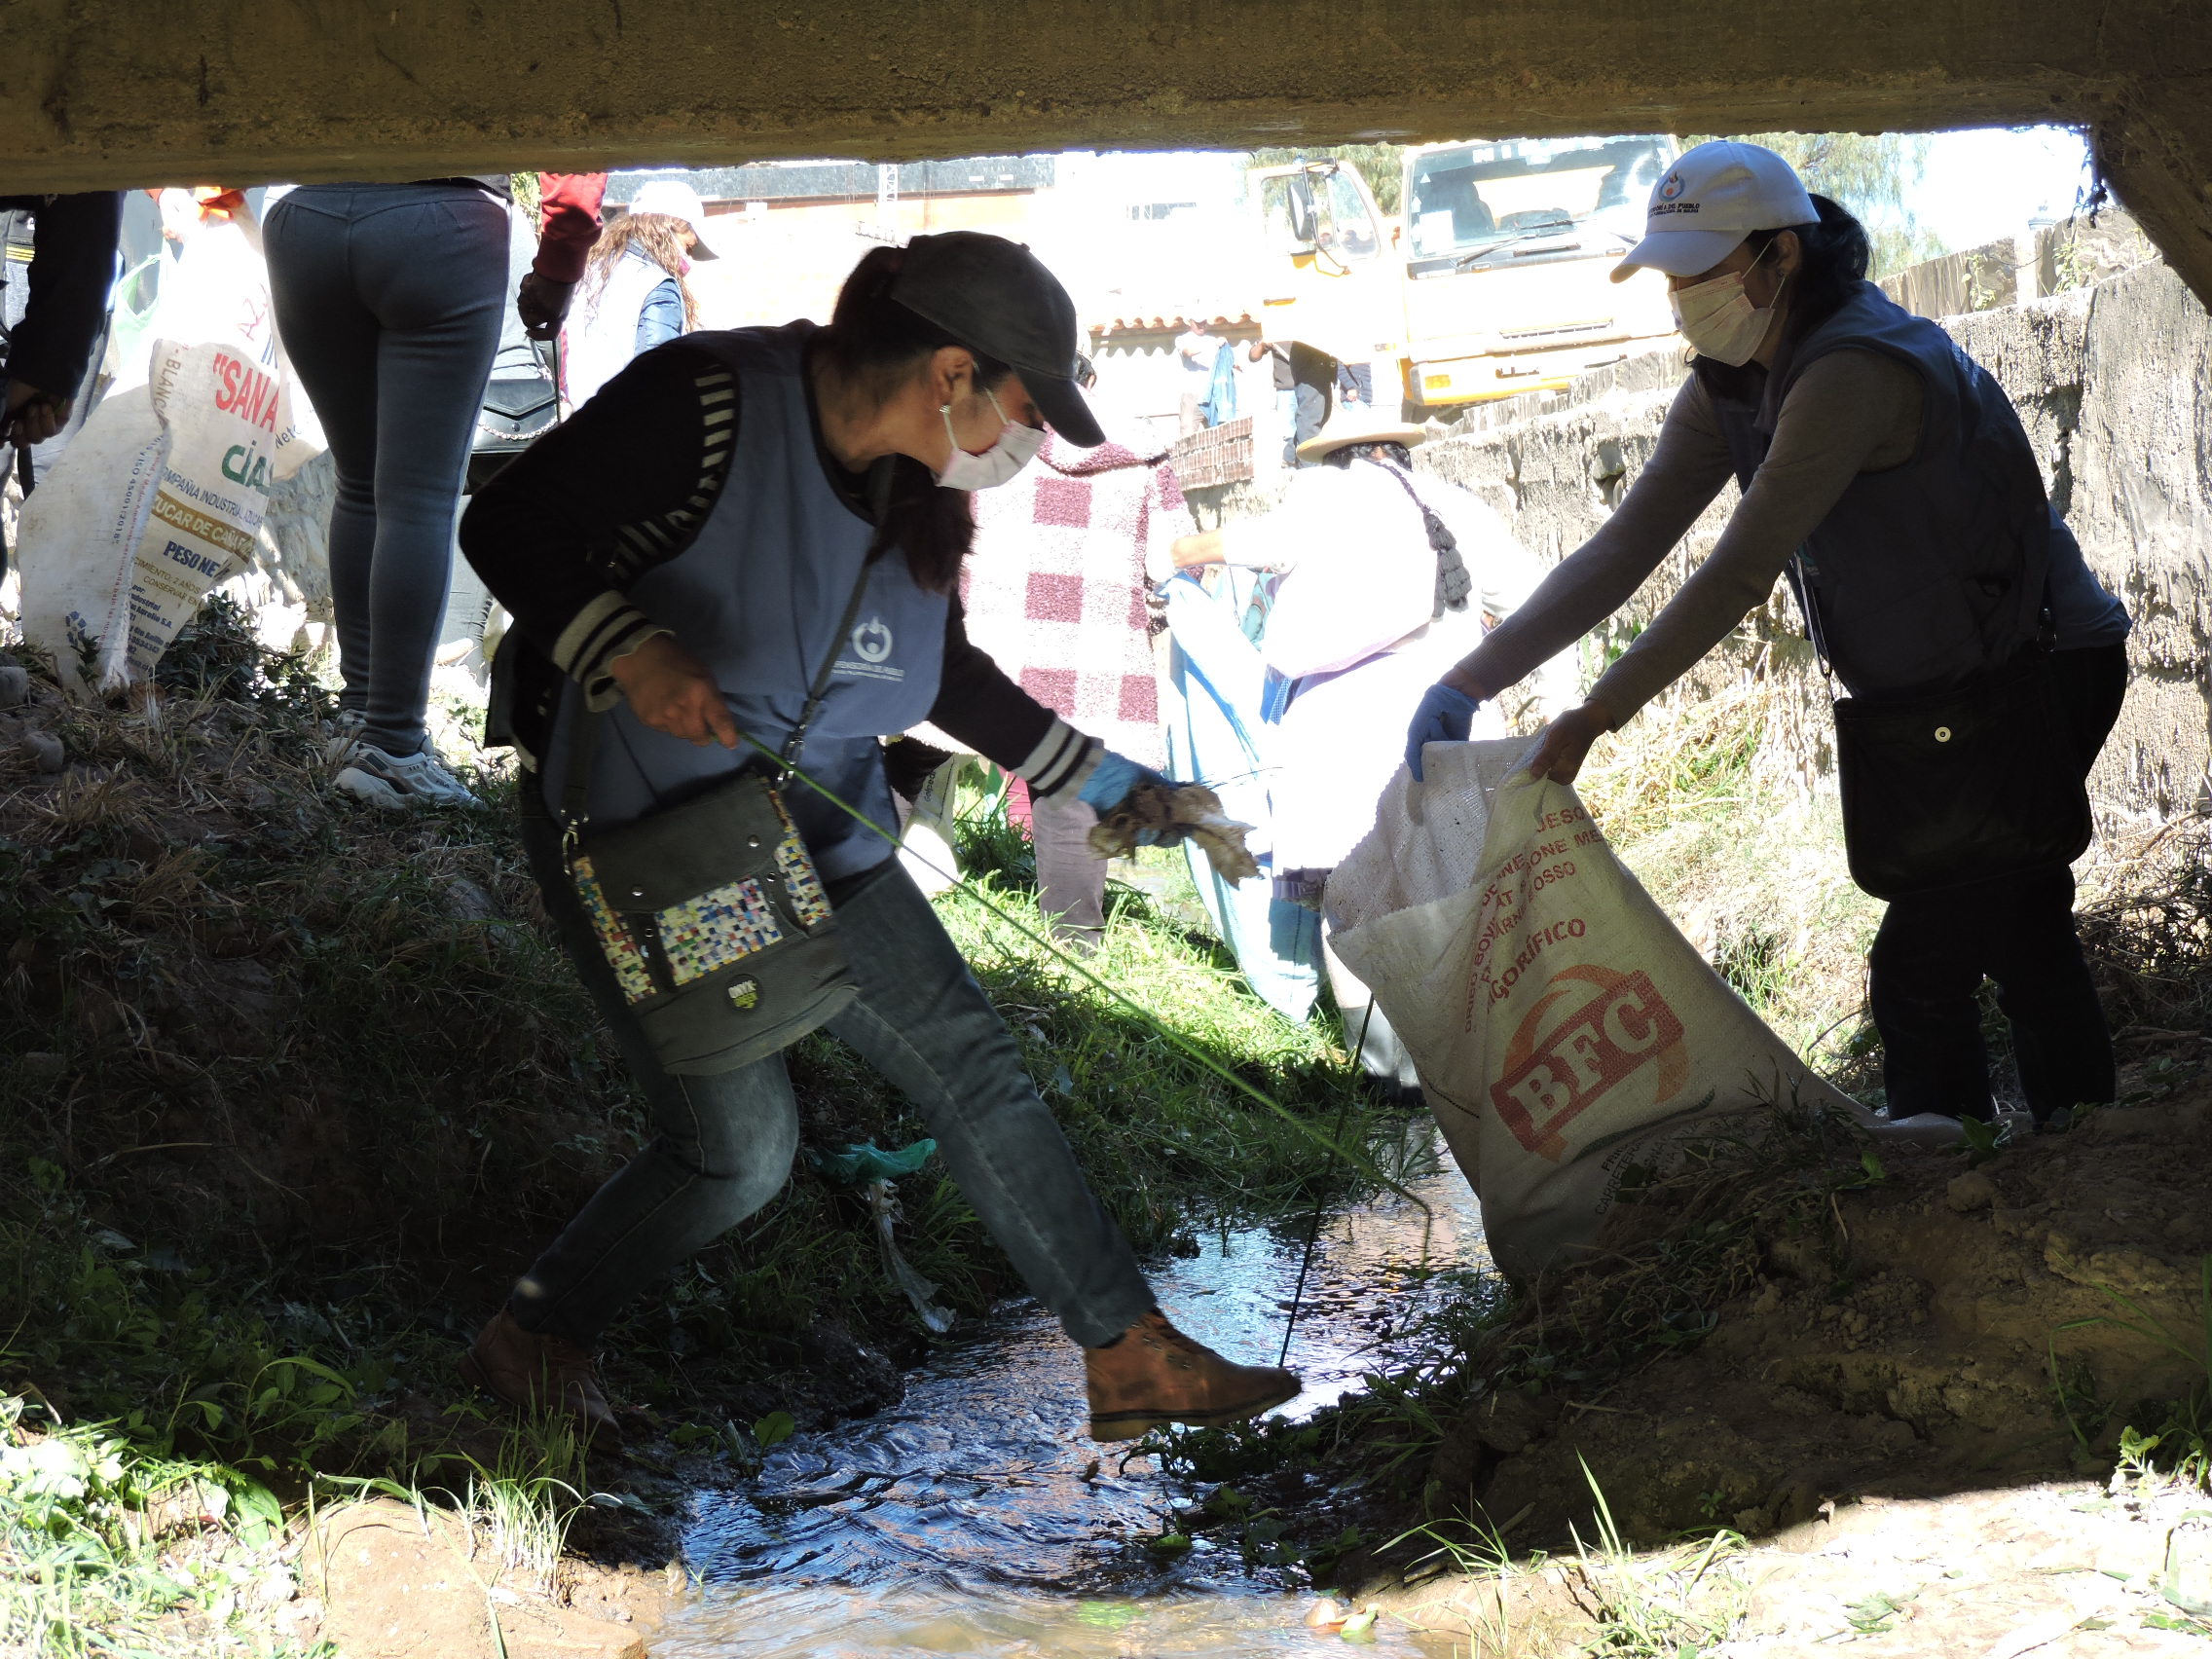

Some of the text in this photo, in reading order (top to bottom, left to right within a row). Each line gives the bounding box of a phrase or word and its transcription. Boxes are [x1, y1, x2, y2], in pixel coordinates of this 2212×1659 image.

[154, 357, 182, 419] BLANC
[194, 518, 214, 536] DE
[131, 556, 171, 584] CIMIENTO:
[163, 540, 224, 578] PESO NE
[143, 575, 187, 601] CONSERVAR
[1573, 828, 1604, 848] ME
[1533, 861, 1577, 892] OSSO
[1507, 983, 1661, 1137] BFC
